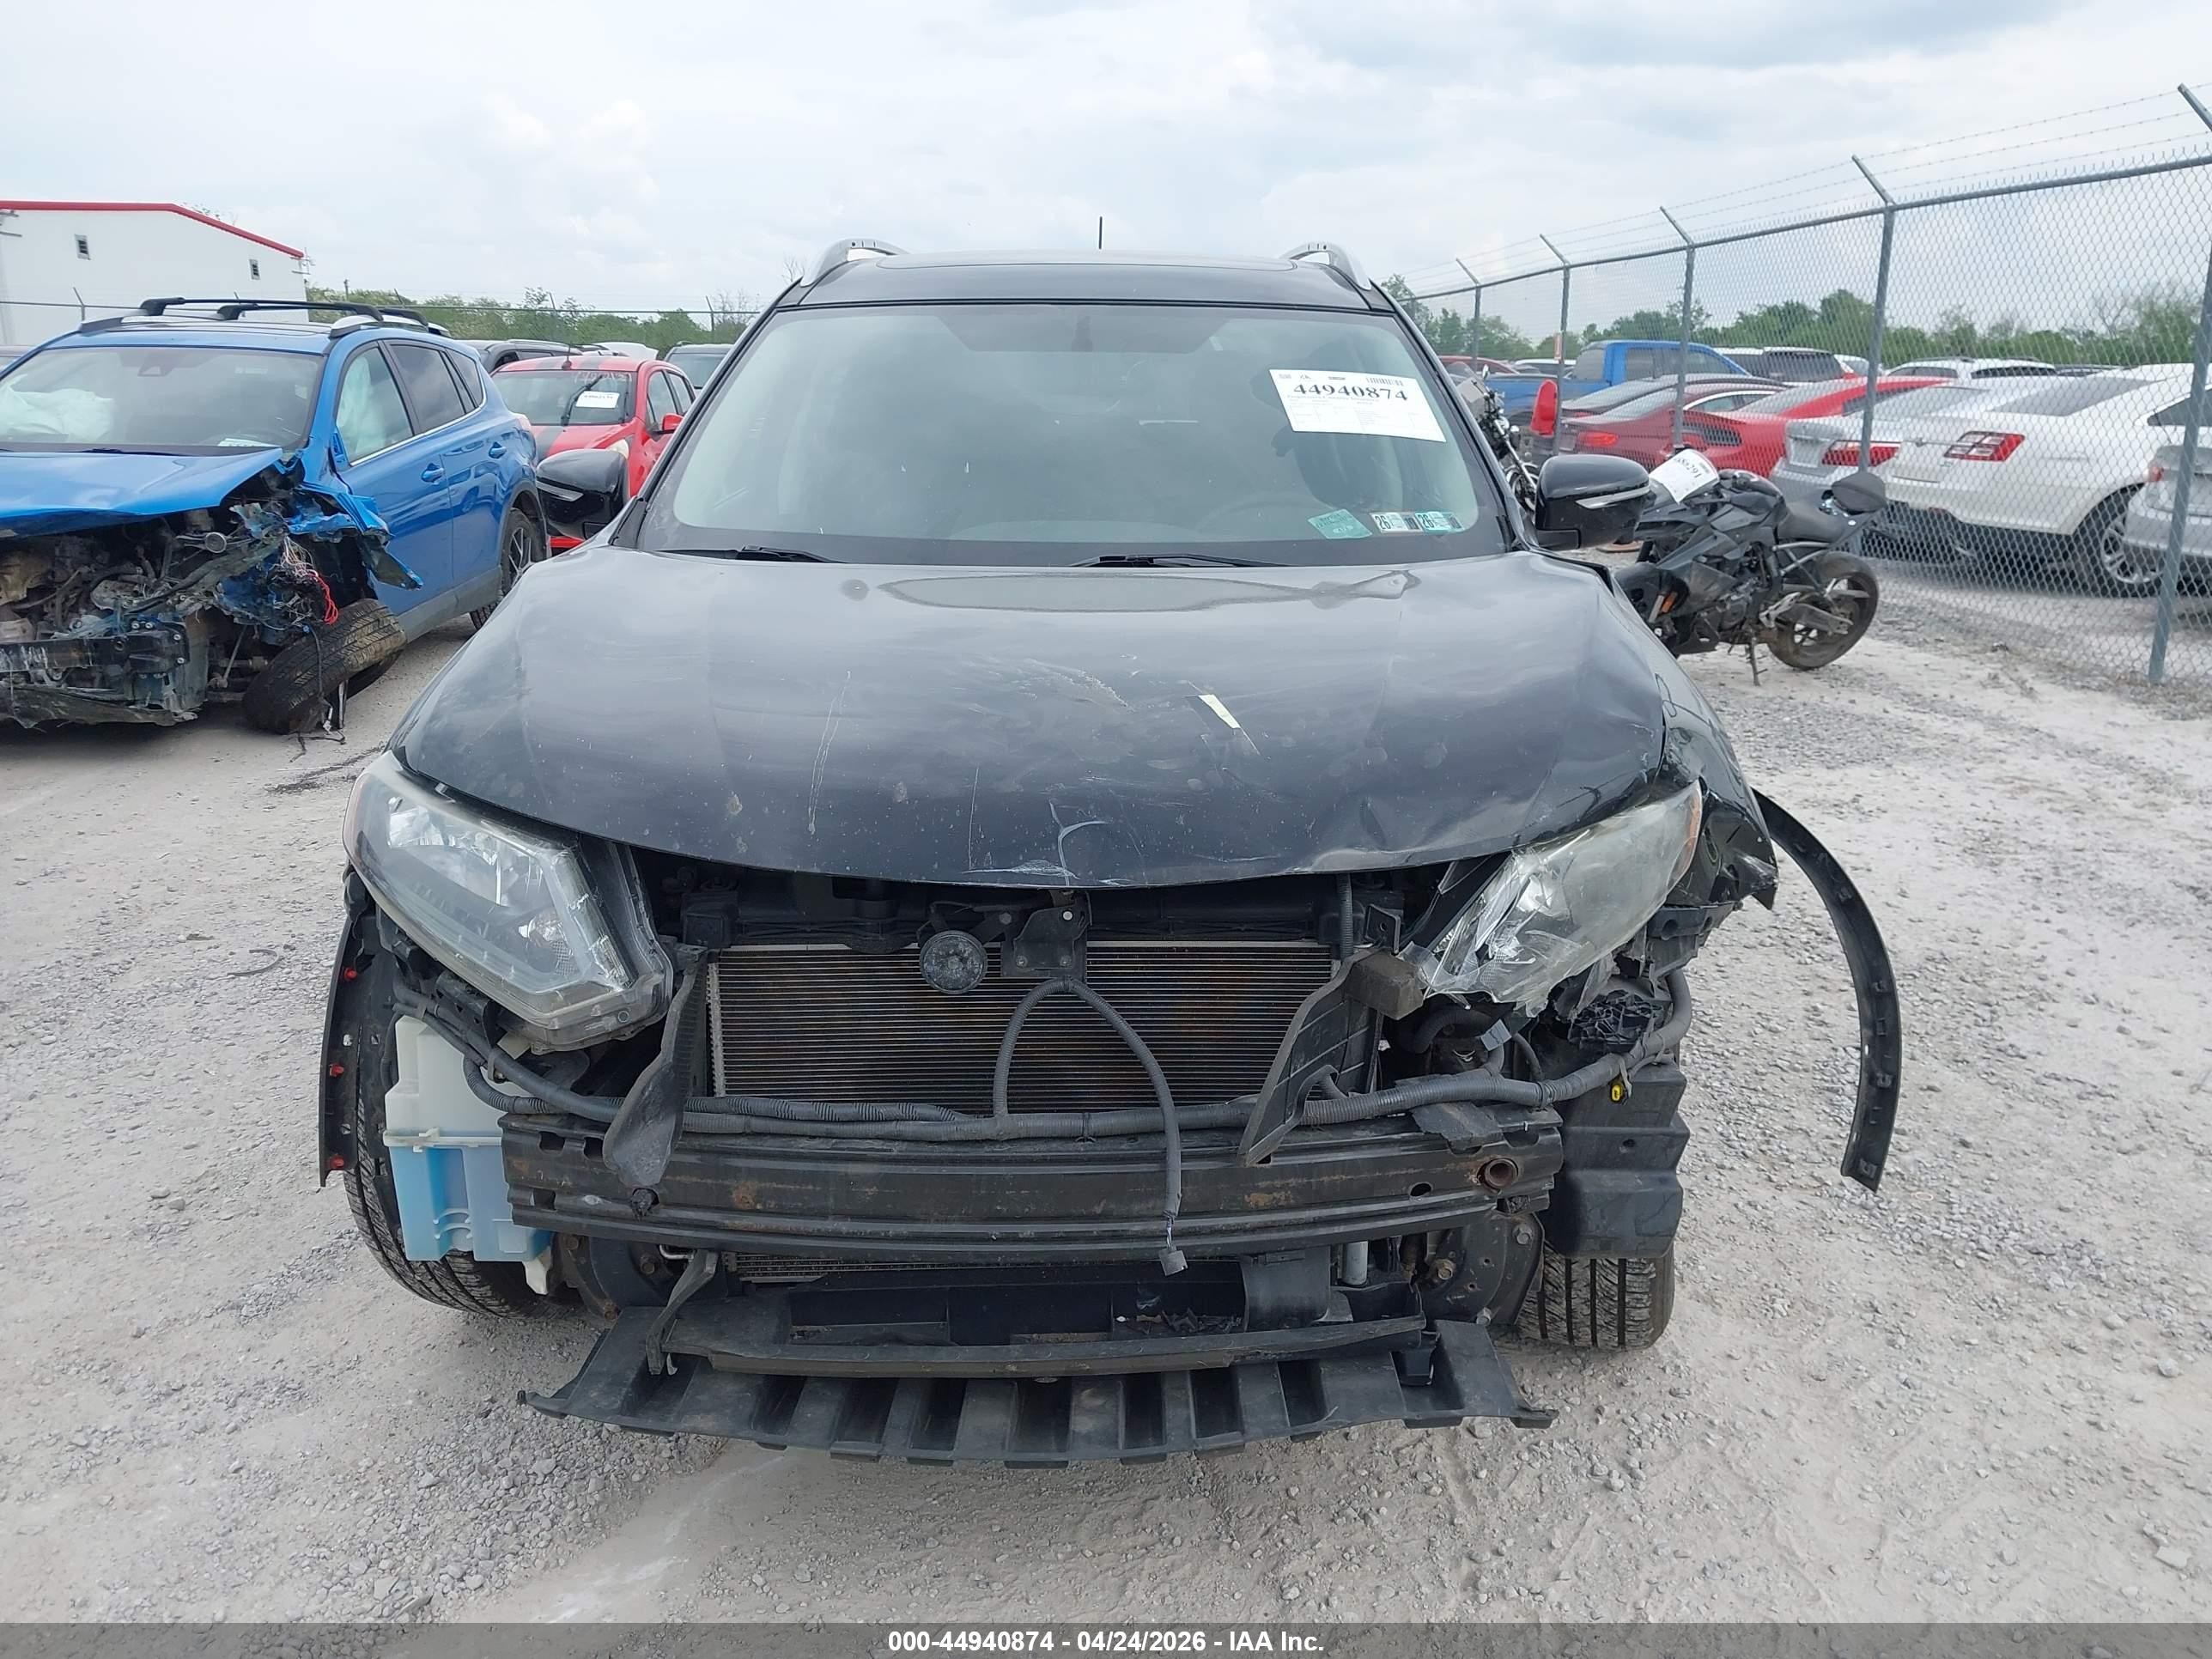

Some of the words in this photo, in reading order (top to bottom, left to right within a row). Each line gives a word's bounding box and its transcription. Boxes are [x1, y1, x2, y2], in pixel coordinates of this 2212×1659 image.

[1293, 384, 1408, 401] 44940874
[1375, 514, 1391, 530] 26
[1418, 514, 1435, 529] 26
